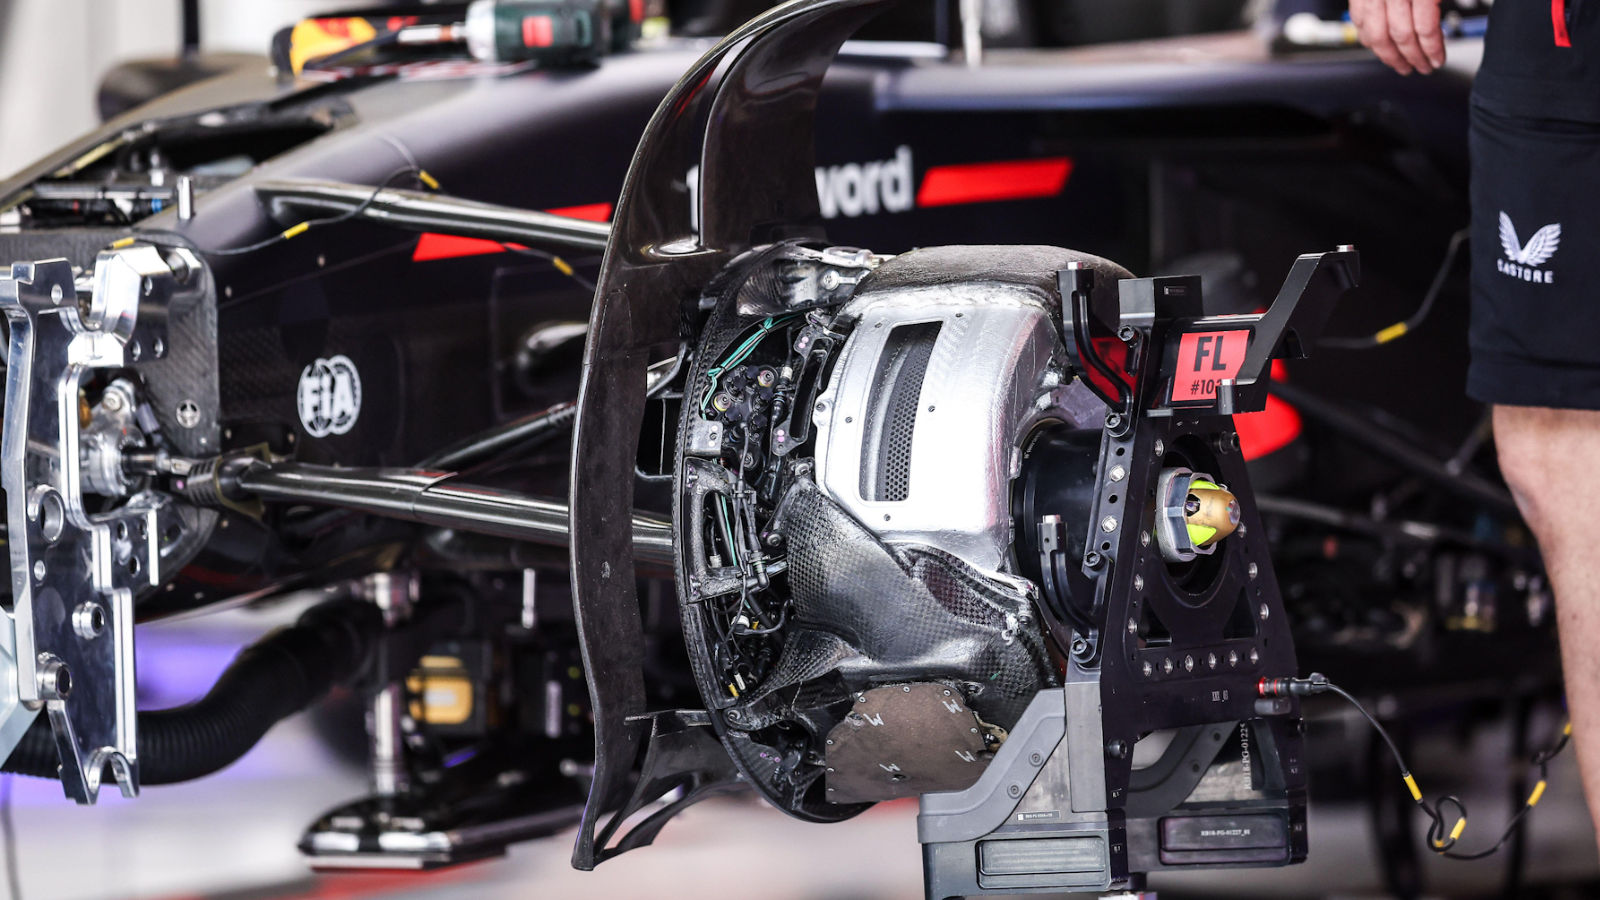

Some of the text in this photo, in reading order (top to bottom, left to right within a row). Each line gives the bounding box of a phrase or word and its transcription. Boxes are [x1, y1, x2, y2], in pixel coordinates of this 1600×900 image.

[1497, 258, 1554, 284] CASTORE
[1193, 335, 1227, 372] FL
[1191, 378, 1222, 395] #10
